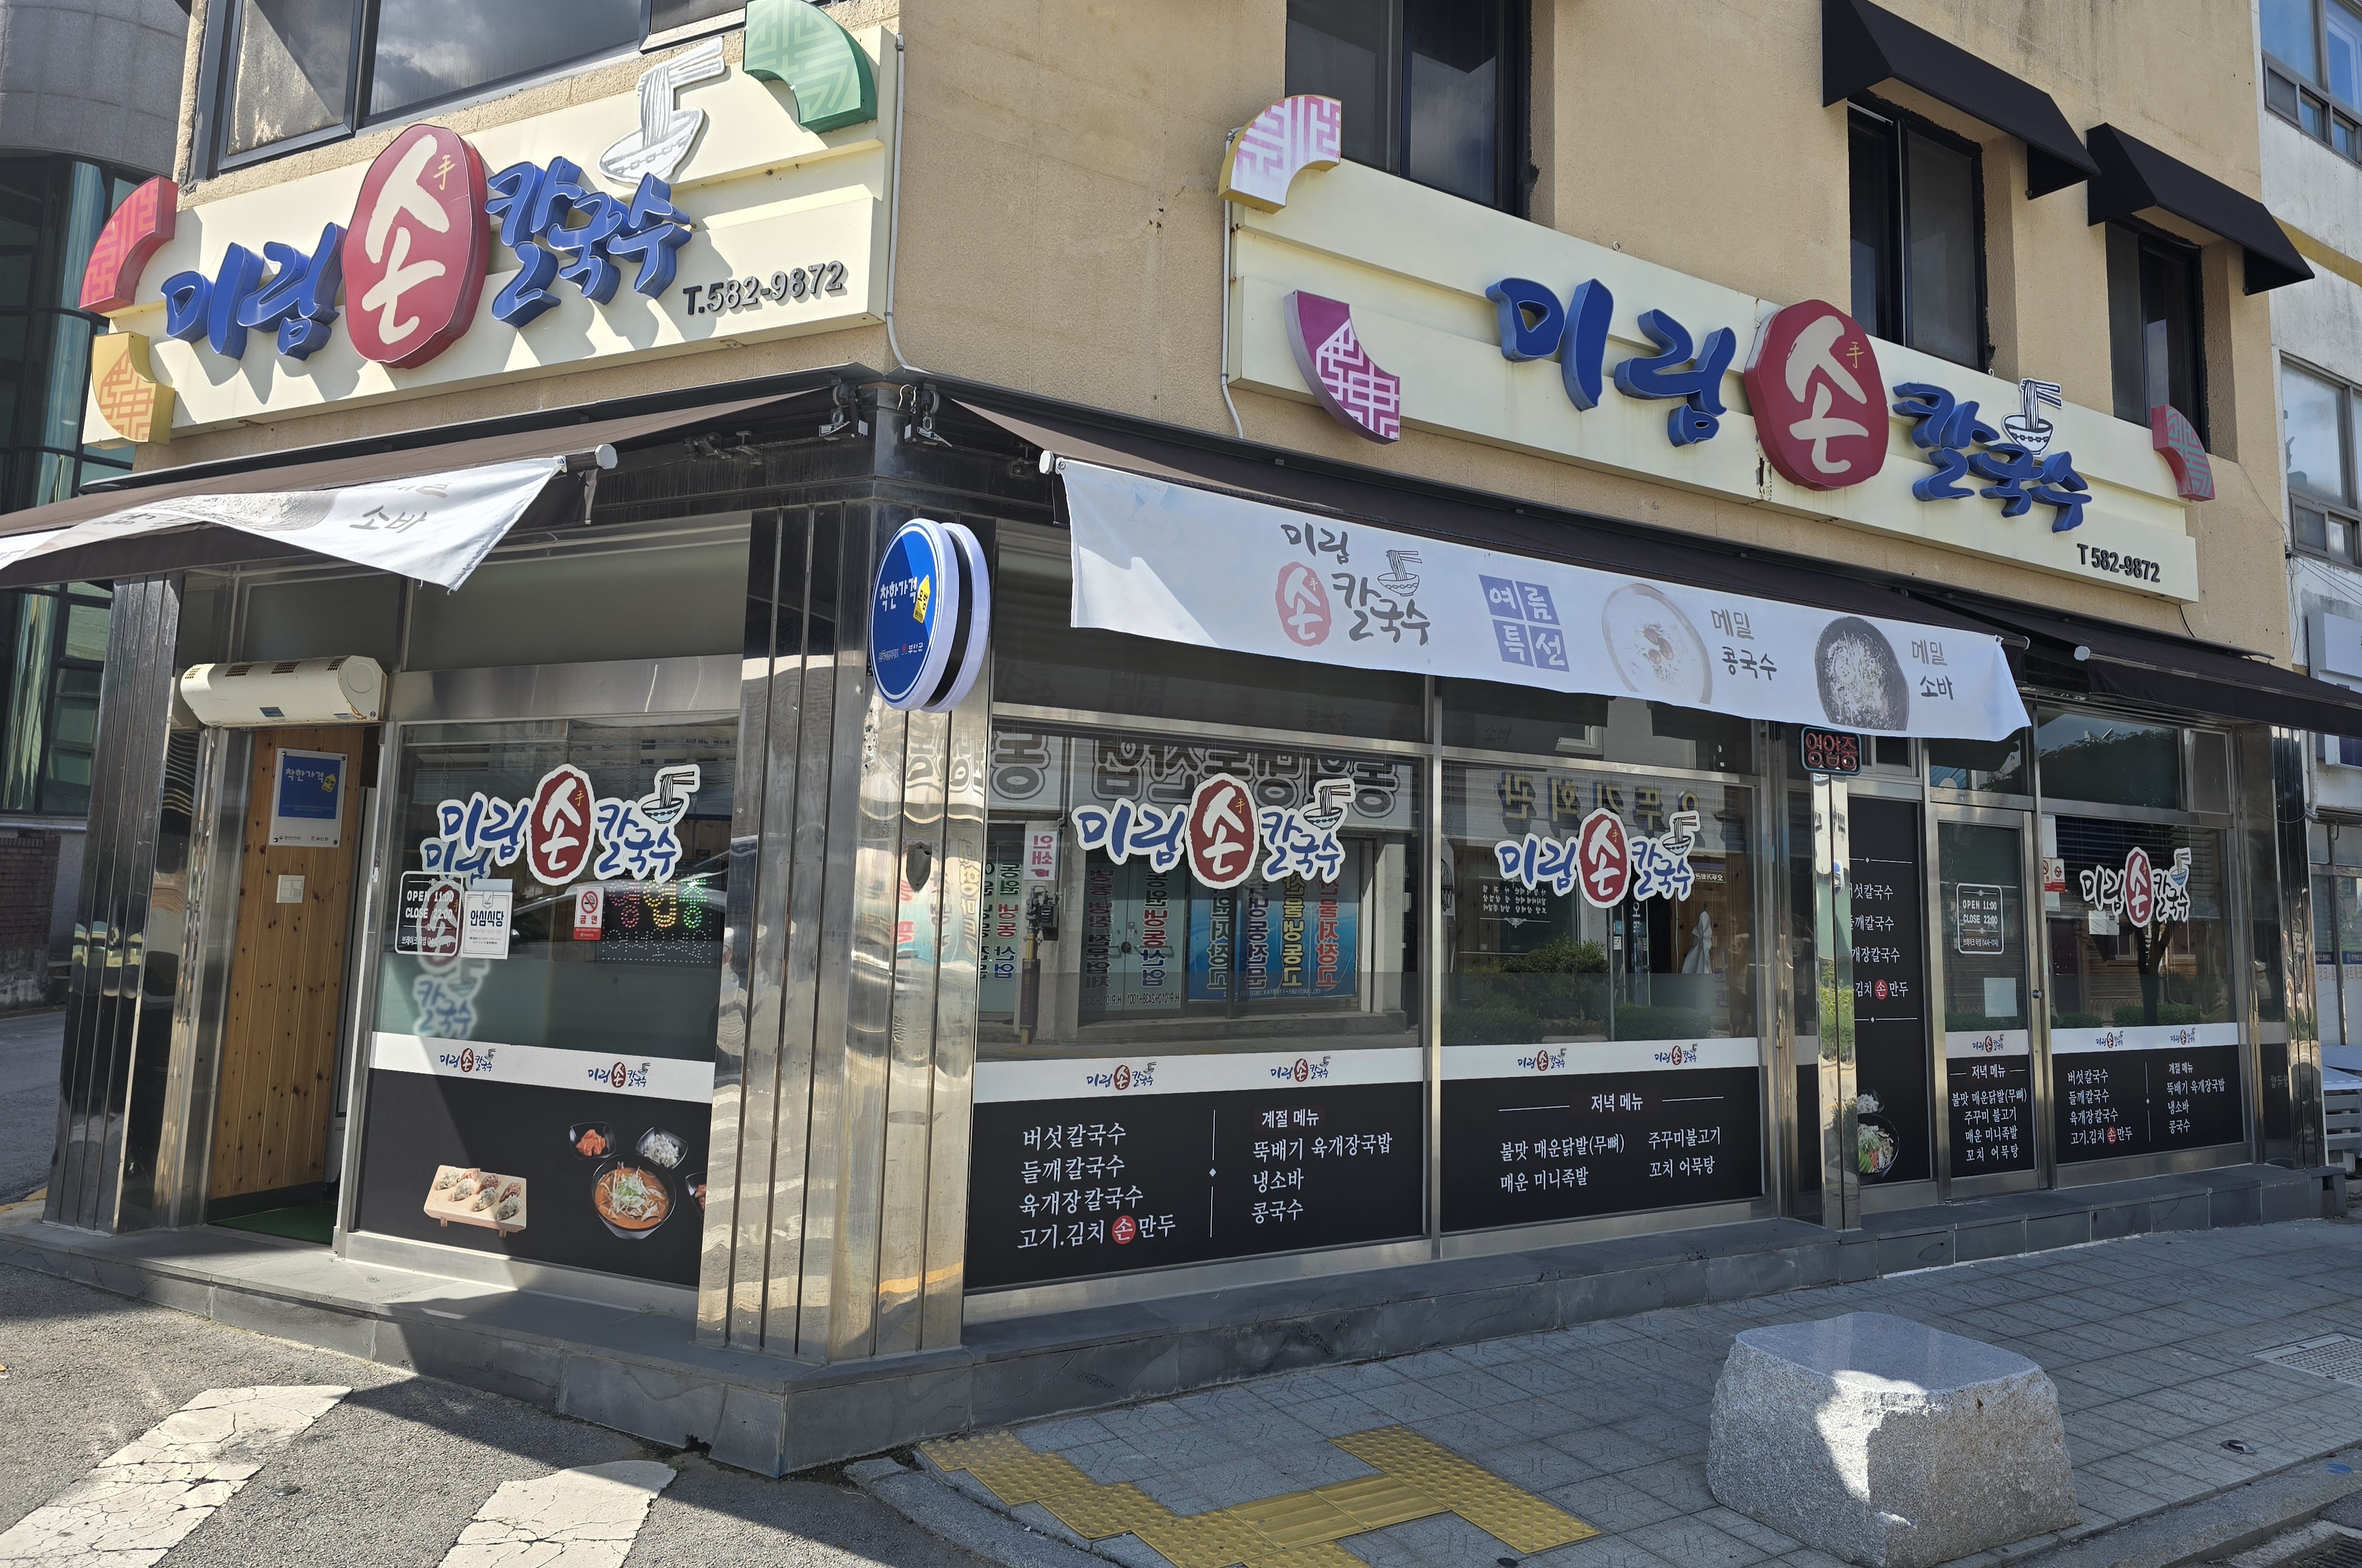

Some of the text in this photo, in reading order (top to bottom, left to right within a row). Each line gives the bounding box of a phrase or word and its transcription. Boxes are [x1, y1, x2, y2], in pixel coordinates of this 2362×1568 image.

[161, 135, 693, 361] 미림 손 칼국수
[683, 261, 843, 315] T.582-9872
[1485, 277, 2092, 533] 미림 손 칼국수
[1281, 522, 1349, 564] 미림
[880, 577, 918, 612] 착한가격
[1489, 586, 1551, 622] 여름
[1286, 567, 1431, 646] 손 칼국수
[1710, 609, 1754, 642] 메밀
[1503, 630, 1568, 667] 특선
[1911, 639, 1947, 667] 메밀
[1721, 648, 1777, 681] 콩국수
[1921, 675, 1955, 701] 소바
[1805, 732, 1858, 771] 영업중
[285, 768, 324, 783] 착한가격
[441, 778, 677, 876] 미림 손 칼국수
[1078, 786, 1340, 876] 미림 손 칼국수
[1499, 820, 1692, 897] 미림 손 칼국수
[407, 890, 454, 902] OPEN 11:00
[2130, 855, 2148, 918] 손
[405, 907, 453, 919] CLOSE 22:00
[1963, 900, 1997, 911] OPEN 11:00
[471, 910, 504, 927] 안심식당
[1850, 914, 1894, 932] 깨칼국수
[1963, 914, 1998, 925] CLOSE 22:00
[1889, 981, 1908, 998] 만두
[440, 1050, 492, 1072] 미림 손 칼국수
[1518, 1052, 1565, 1070] 미림 손 칼국수
[1655, 1047, 1698, 1064] 미림 손 칼국수
[588, 1064, 647, 1087] 미림 손 칼국수
[1087, 1066, 1154, 1089] 미림 손 칼국수
[1270, 1060, 1329, 1080] 미림 손 칼국수
[1972, 1064, 2006, 1079] 저녁 메뉴
[2067, 1069, 2109, 1085] 버섯칼국수
[2169, 1062, 2193, 1074] 계절 메뉴
[1951, 1087, 2027, 1107] 불맛 매운닭발(무뼈)
[2069, 1089, 2109, 1105] 들깨칼국수
[2167, 1078, 2225, 1095] 뚝배기 육개장국밥
[1591, 1092, 1643, 1114] 저녁 메뉴
[2168, 1099, 2189, 1115] 냉소바
[1262, 1109, 1319, 1128] 계절 메뉴
[1964, 1106, 2017, 1125] 주꾸미 불고기
[2069, 1108, 2119, 1125] 육개장칼국수
[2168, 1118, 2190, 1134] 콩국수
[1023, 1122, 1127, 1152] 버섯칼국수
[1647, 1126, 1721, 1151] 주꾸미불고기
[1965, 1125, 2018, 1144] 매운 미니족발
[2071, 1128, 2105, 1145] 고기.김치
[2117, 1126, 2133, 1141] 만두
[1252, 1132, 1393, 1163] 뚝배기 육개장국밥
[1499, 1133, 1625, 1162] 불맛 매운닭발(무뼈)
[1966, 1144, 2019, 1162] 꼬치 어묵탕
[1021, 1154, 1125, 1184] 들깨칼국수
[1649, 1155, 1715, 1178] 꼬치 어묵탕
[1252, 1168, 1304, 1194] 냉소바
[1500, 1167, 1588, 1194] 매운 미니족발
[1019, 1185, 1144, 1219] 육개장칼국수
[1251, 1198, 1304, 1225] 콩국수
[1017, 1219, 1105, 1250] 고기.김치
[1138, 1214, 1176, 1240] 만두
